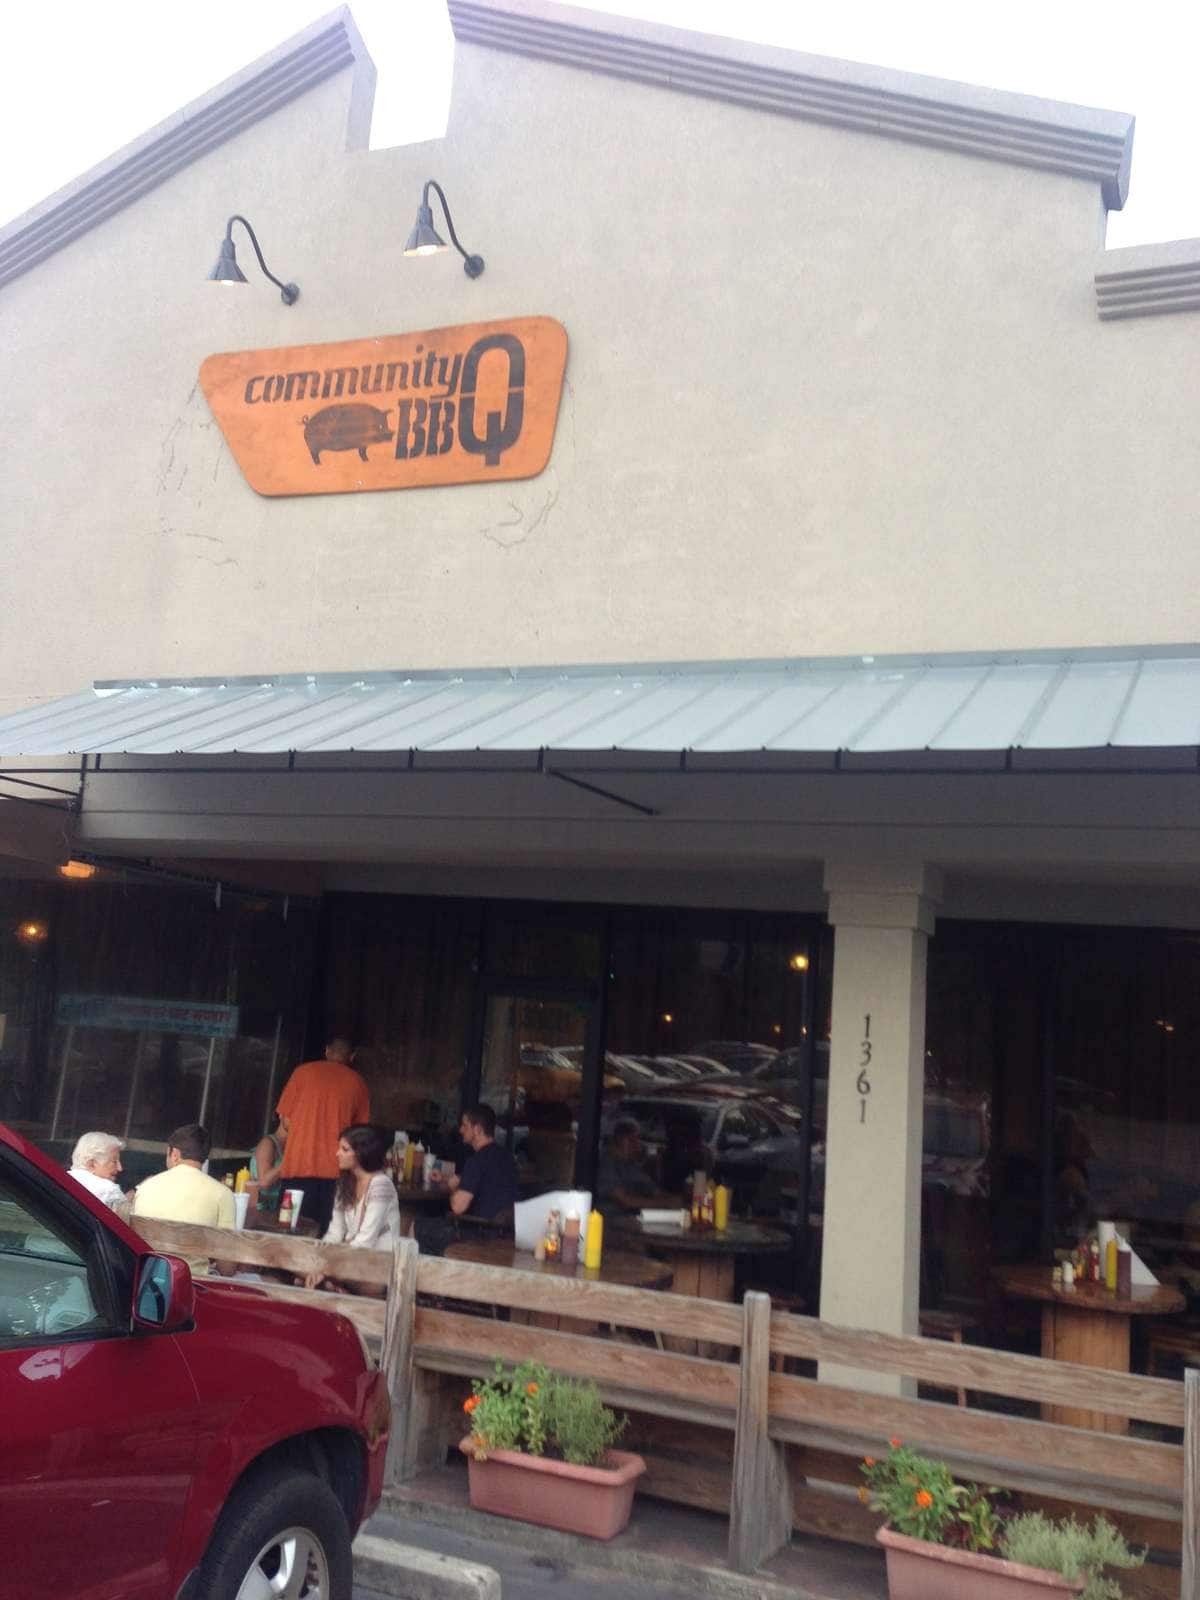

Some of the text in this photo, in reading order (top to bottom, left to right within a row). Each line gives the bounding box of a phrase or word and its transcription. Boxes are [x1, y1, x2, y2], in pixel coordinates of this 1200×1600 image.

[244, 344, 464, 405] community
[394, 333, 526, 466] BBQ
[856, 1012, 872, 1124] 1361
